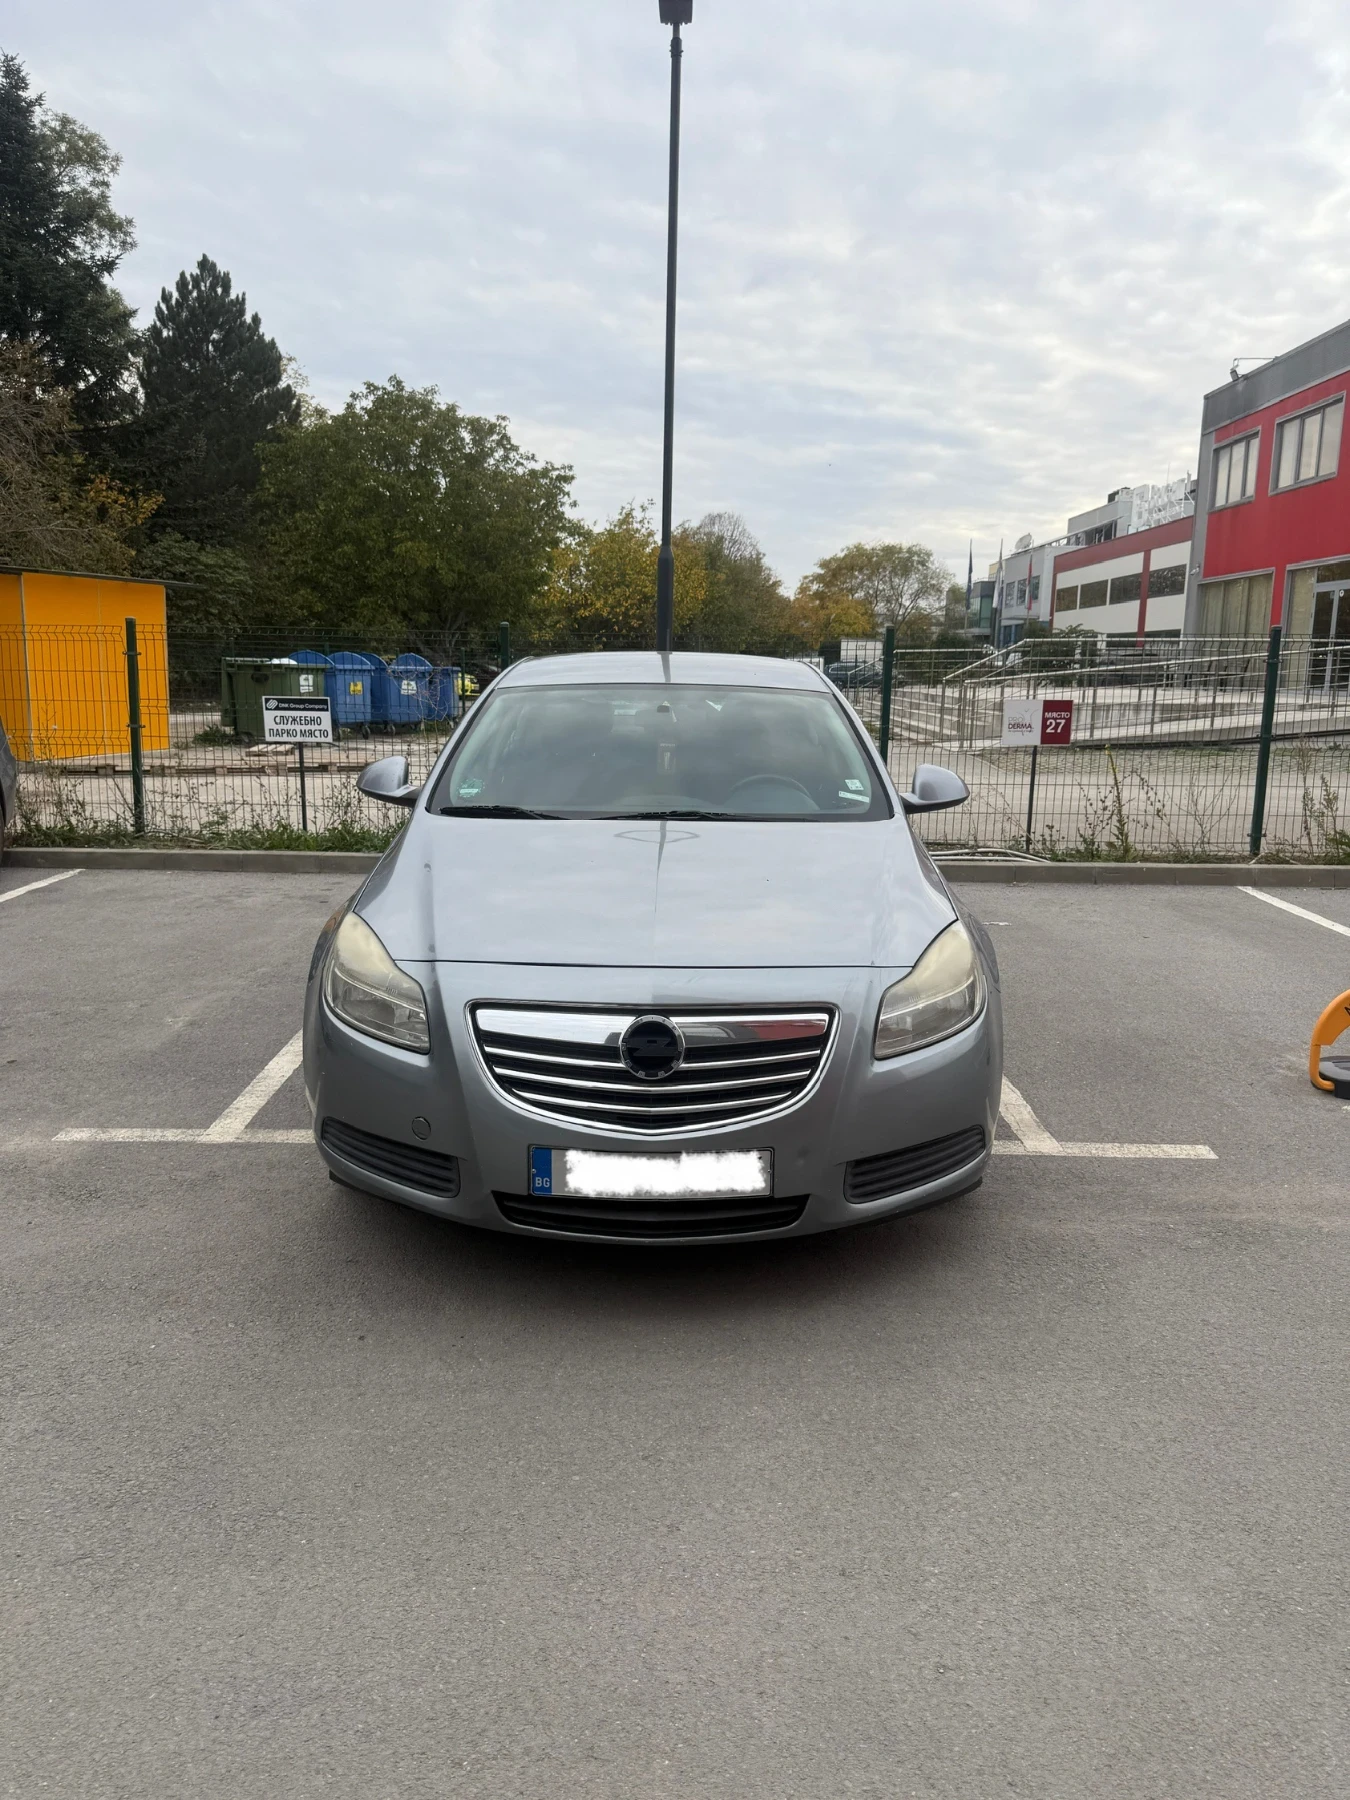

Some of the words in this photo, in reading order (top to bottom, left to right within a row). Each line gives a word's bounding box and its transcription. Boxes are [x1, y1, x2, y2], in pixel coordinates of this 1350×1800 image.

[273, 715, 322, 726] СЛУЖЕБНО
[1045, 719, 1066, 733] 27
[268, 728, 298, 738] ПАРКО
[299, 728, 329, 739] МЯСТО
[535, 1177, 550, 1188] BG
